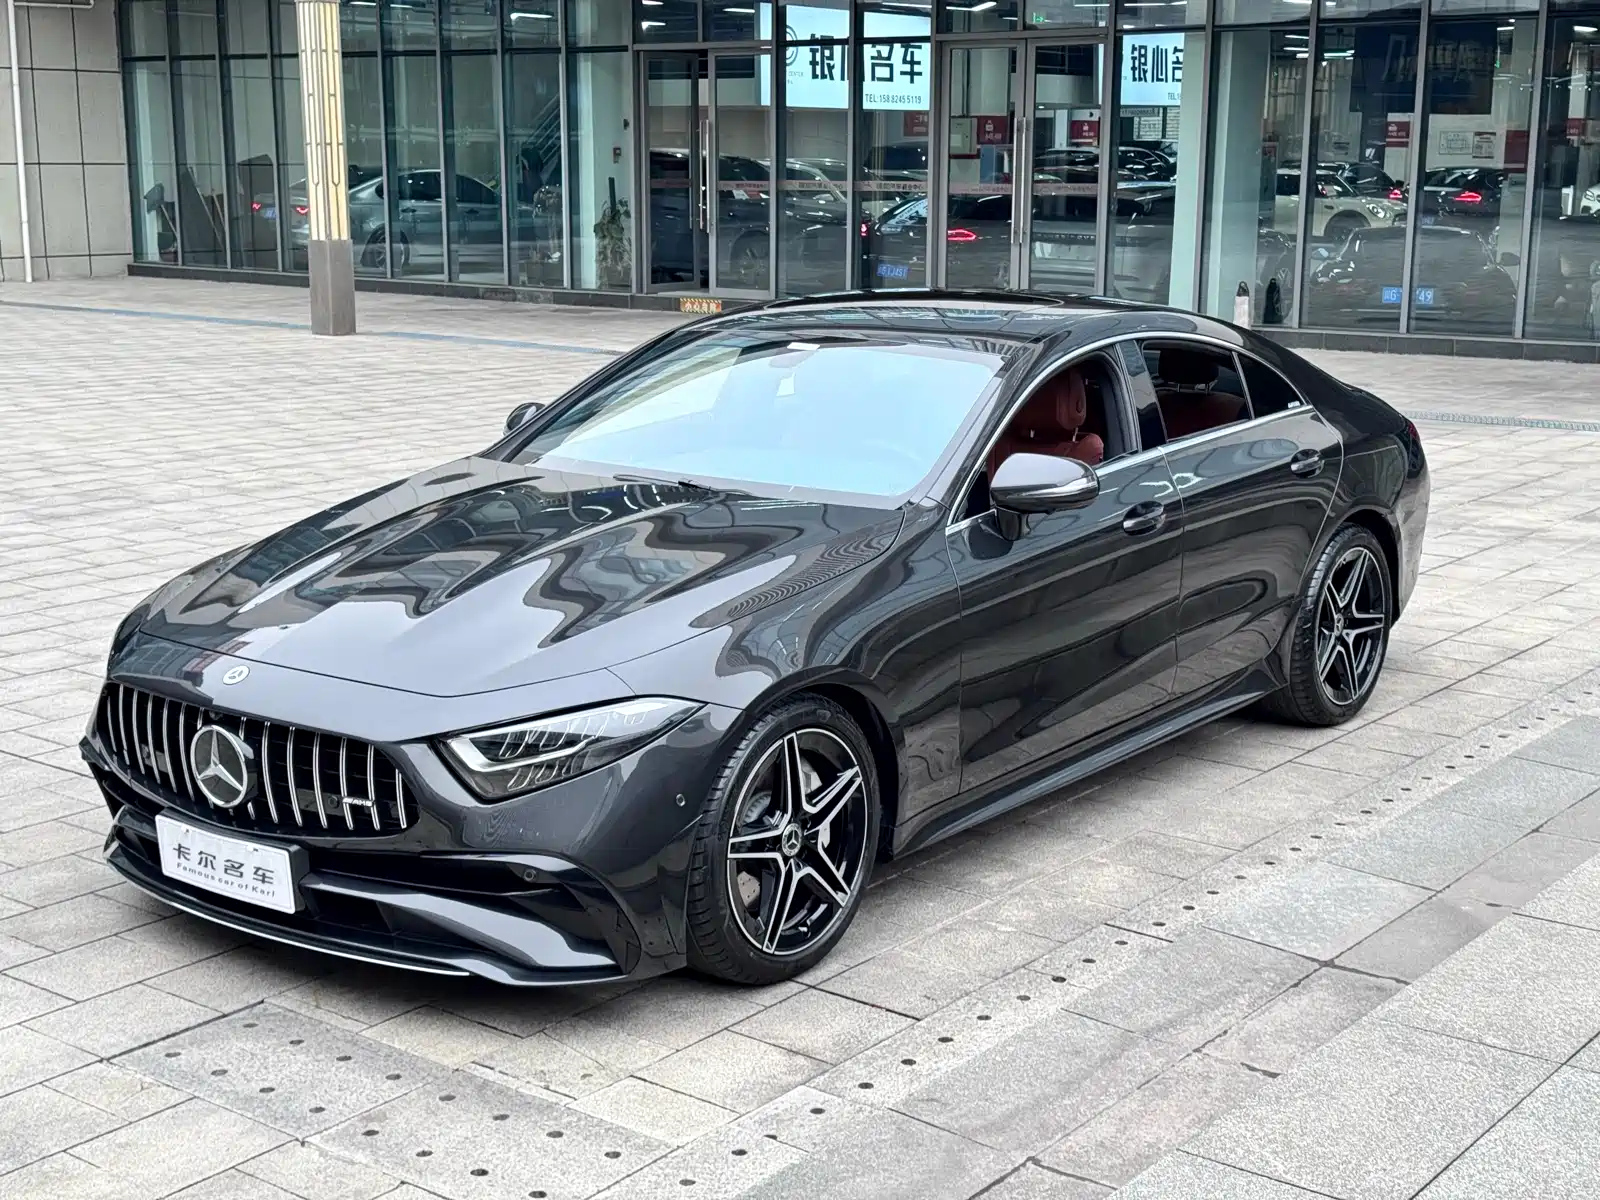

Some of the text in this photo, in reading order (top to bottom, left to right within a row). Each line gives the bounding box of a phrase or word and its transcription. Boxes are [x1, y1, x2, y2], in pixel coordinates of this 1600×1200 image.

[173, 843, 275, 885] 卡尔名车
[177, 862, 276, 898] Famous car of Karl
